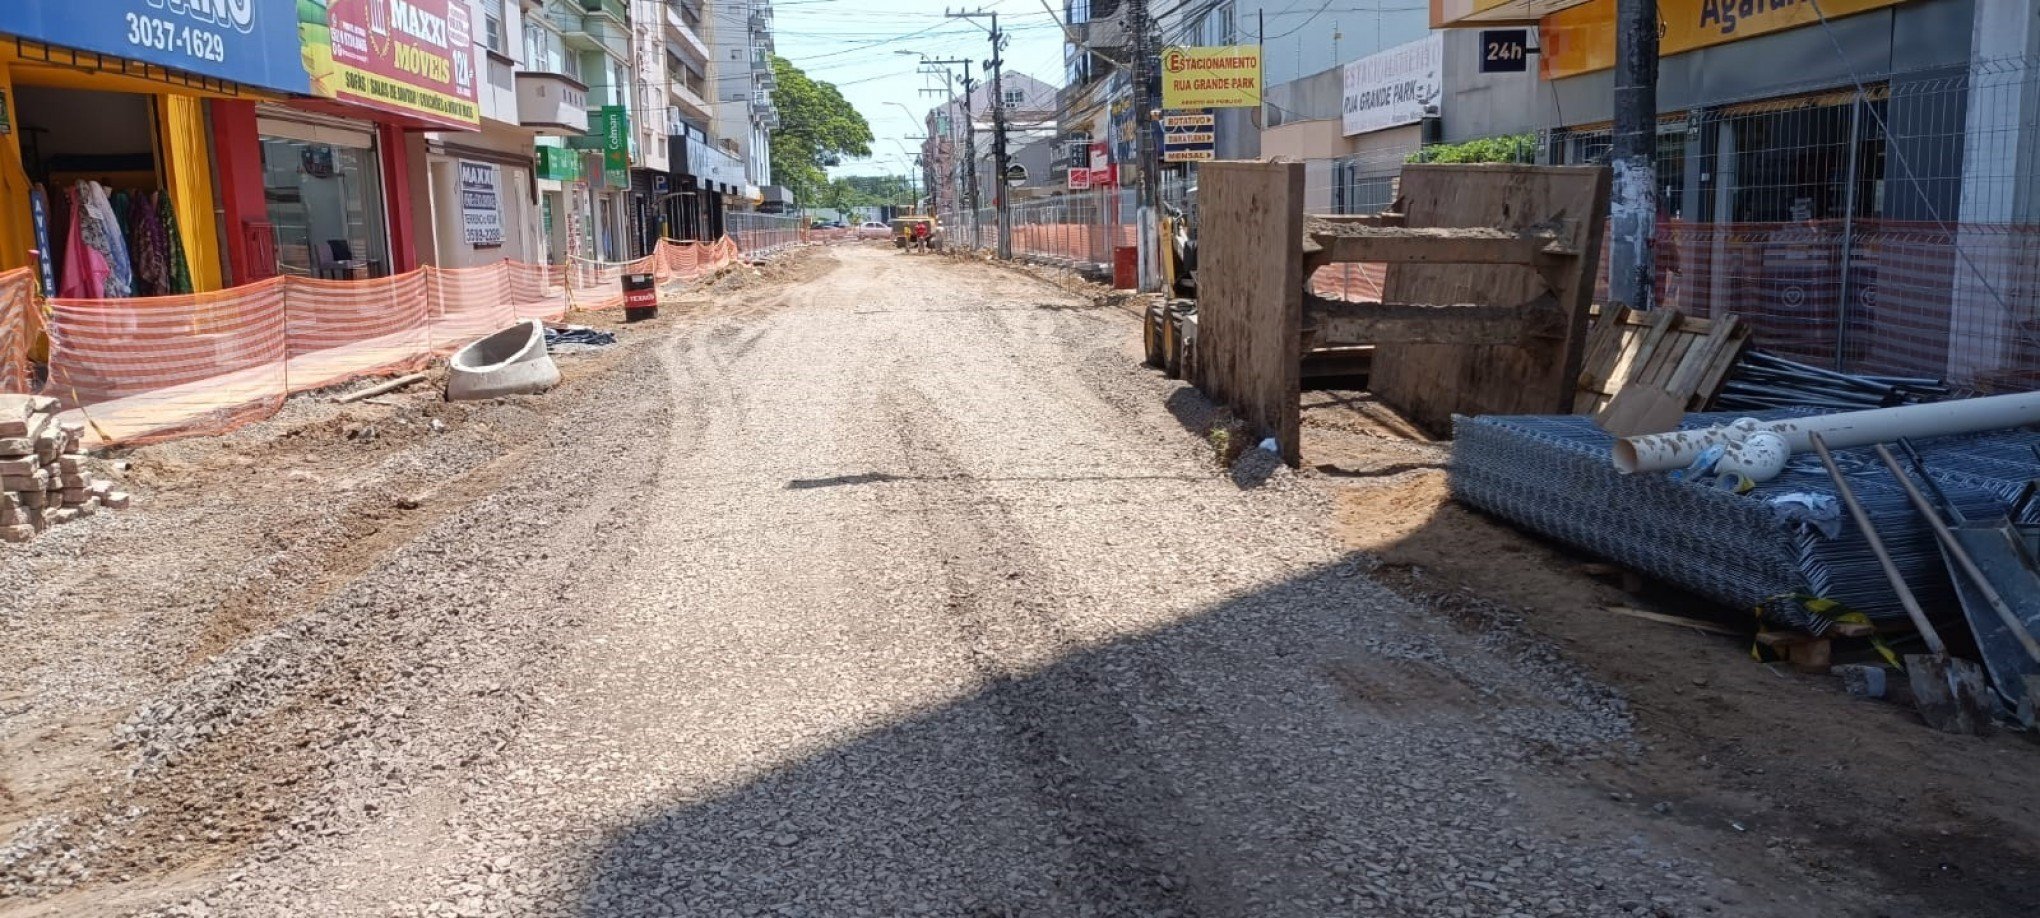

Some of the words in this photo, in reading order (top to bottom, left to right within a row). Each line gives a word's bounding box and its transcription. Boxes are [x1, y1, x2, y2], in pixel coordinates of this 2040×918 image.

[126, 12, 224, 62] 3037-1629
[391, 0, 448, 50] MAXXI
[394, 40, 450, 84] MÓVEIS
[1171, 54, 1257, 71] ESTACIONAMENTO
[1487, 42, 1522, 60] 24h
[1174, 80, 1192, 92] RUA
[1194, 79, 1230, 91] GRANDE
[1232, 77, 1254, 89] PARK
[1344, 95, 1358, 114] RUA
[1360, 86, 1392, 111] GRANDE
[1394, 79, 1417, 103] PARK
[609, 115, 619, 150] Colman
